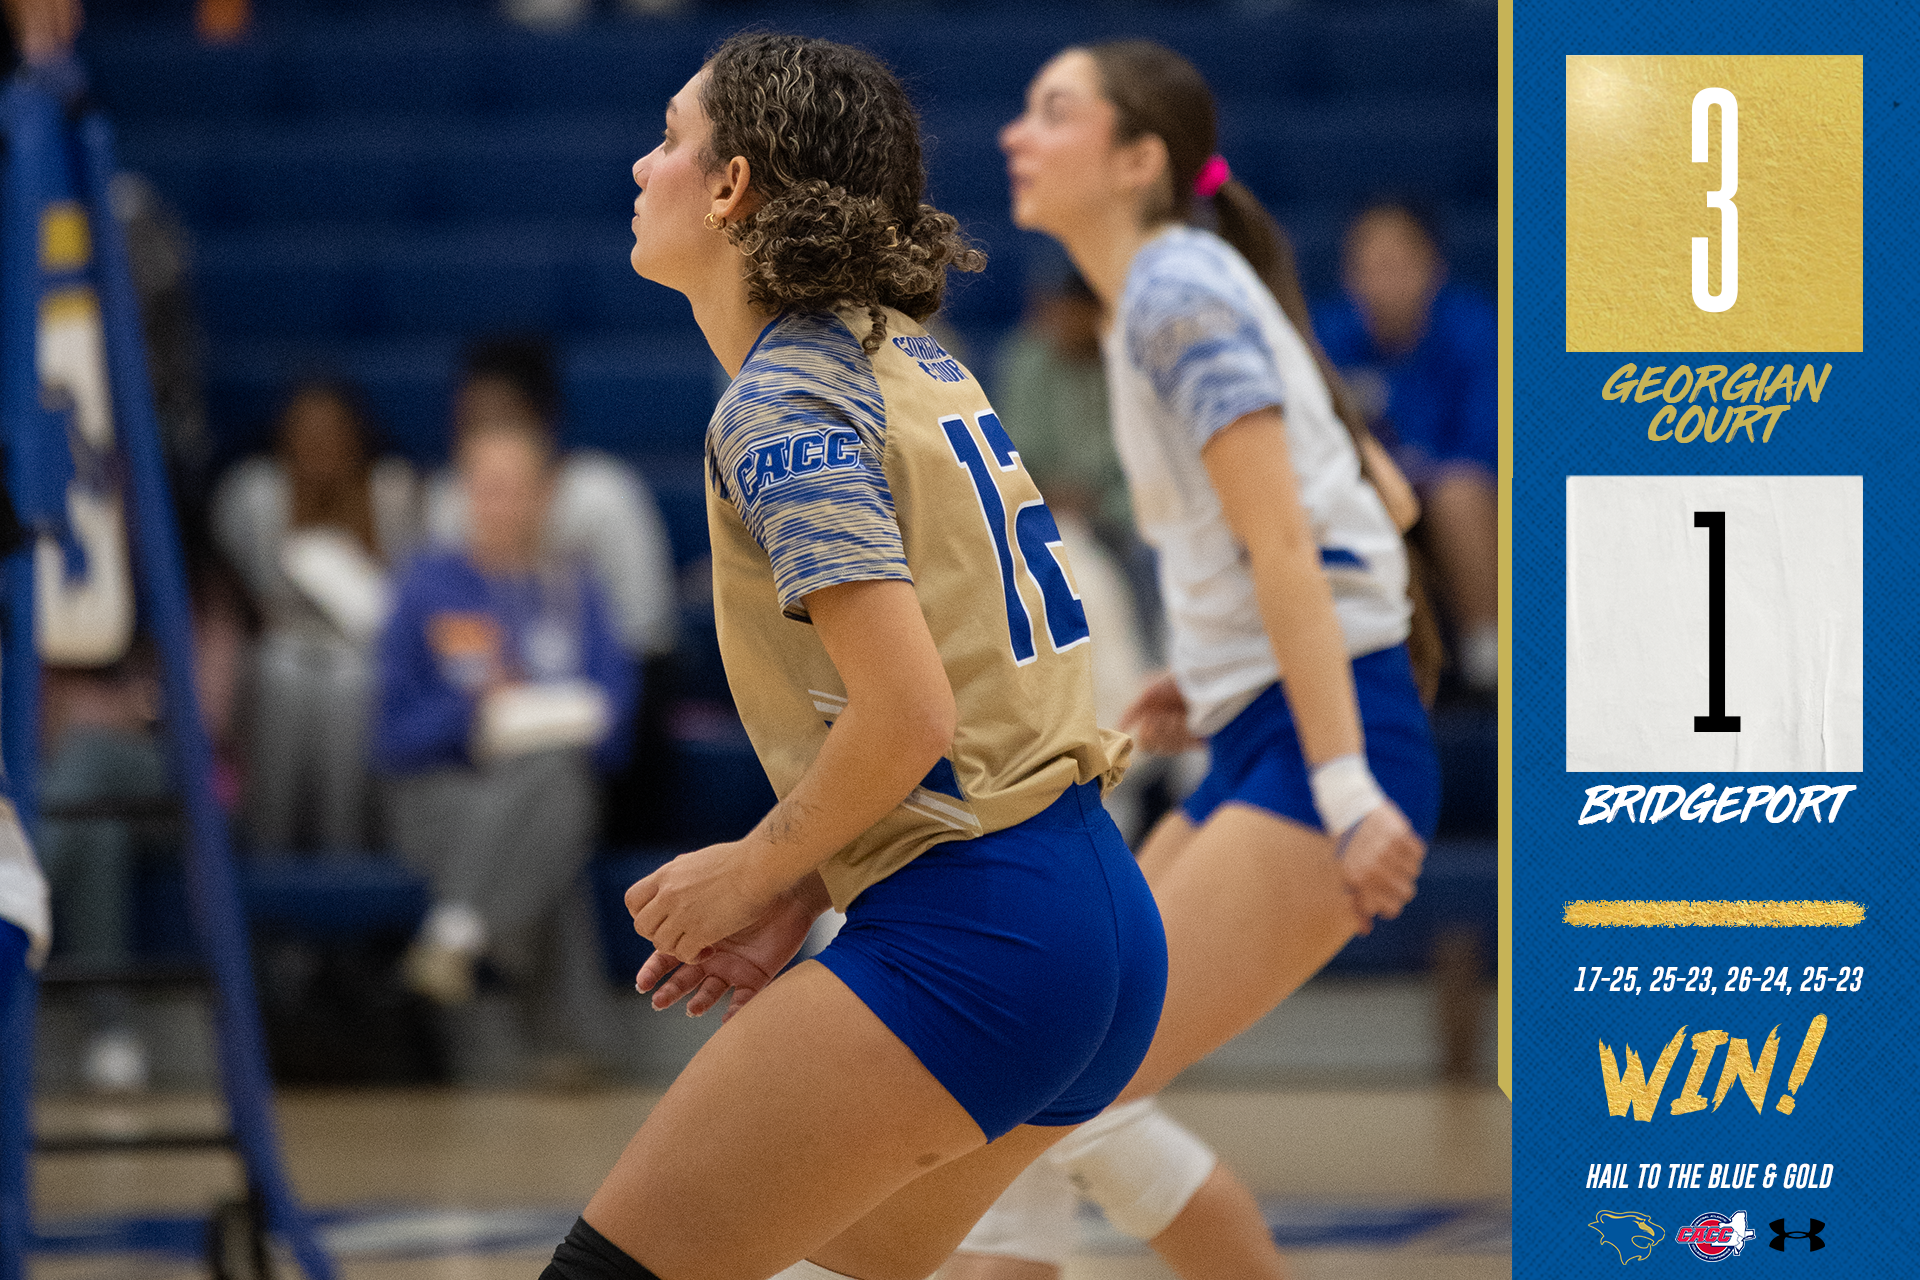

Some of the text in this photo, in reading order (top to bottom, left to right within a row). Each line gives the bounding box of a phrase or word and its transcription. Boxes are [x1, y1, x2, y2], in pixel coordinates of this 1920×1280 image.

[916, 358, 969, 383] COUR
[733, 427, 863, 512] CACC
[938, 408, 1091, 668] 12
